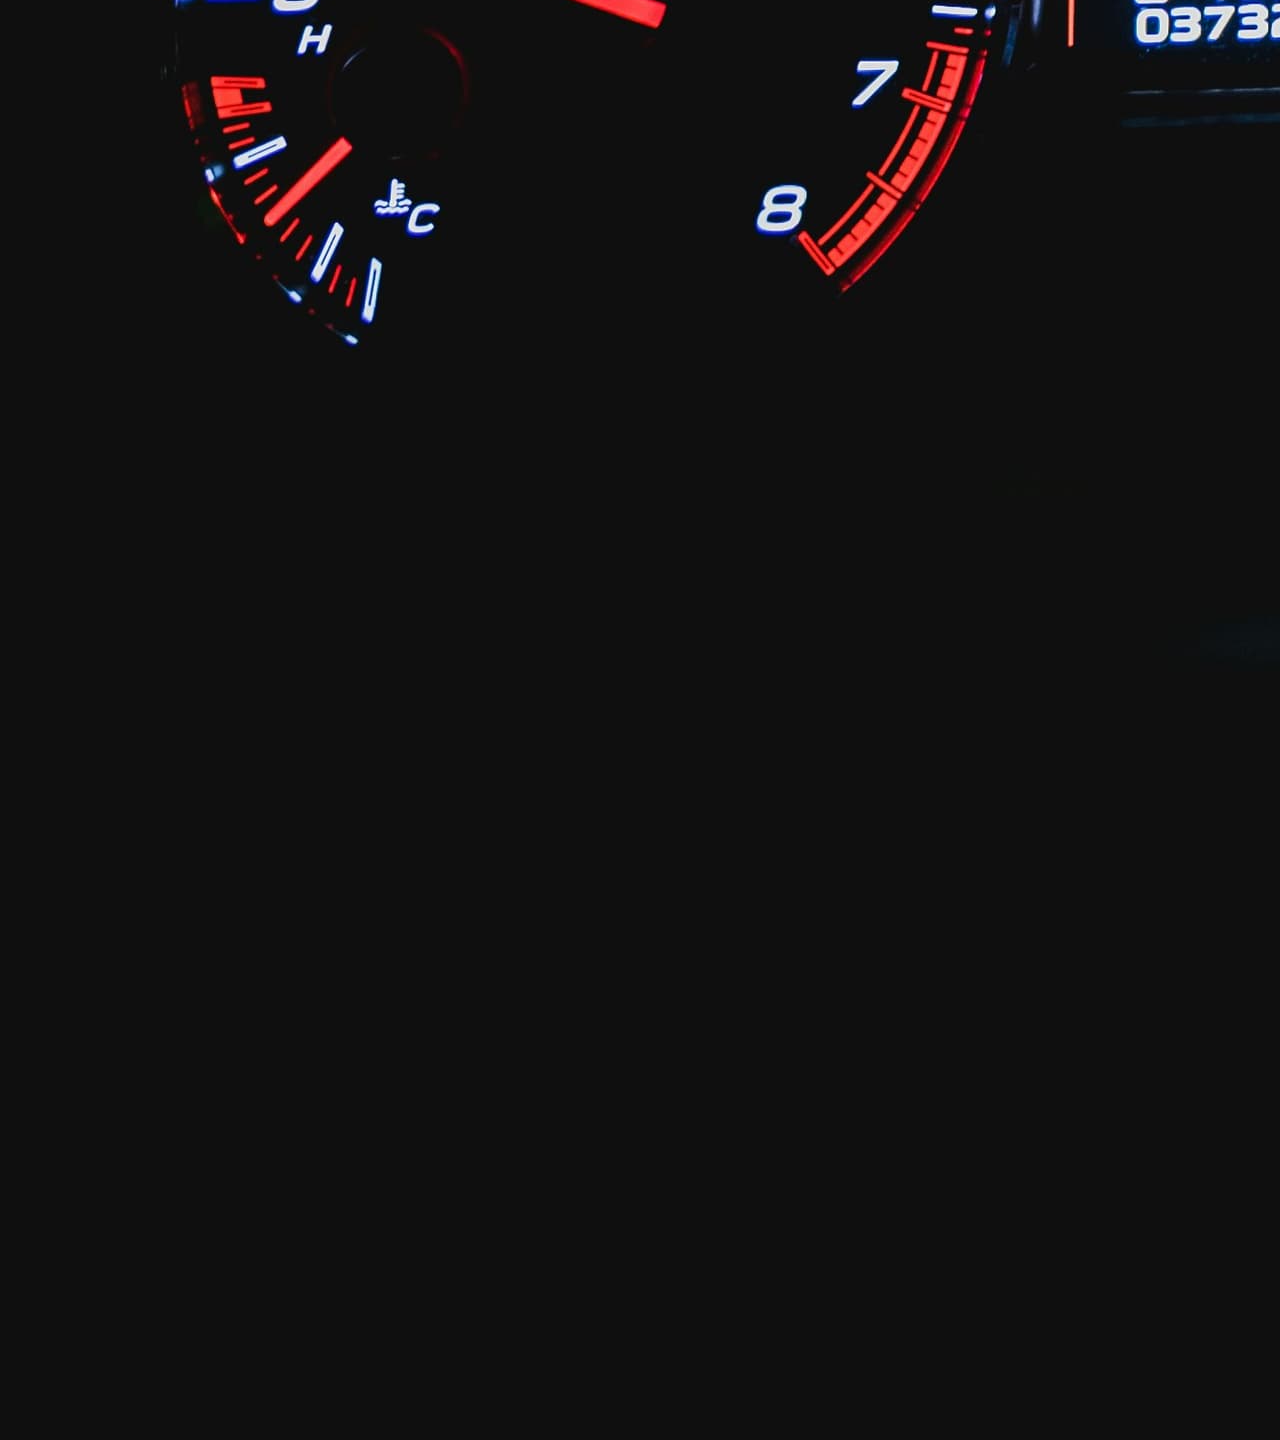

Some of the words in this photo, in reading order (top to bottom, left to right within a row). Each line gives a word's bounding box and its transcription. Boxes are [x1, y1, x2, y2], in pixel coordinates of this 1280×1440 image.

[298, 24, 332, 54] H
[852, 60, 899, 105] 7
[408, 203, 440, 233] C
[757, 185, 807, 231] 8
